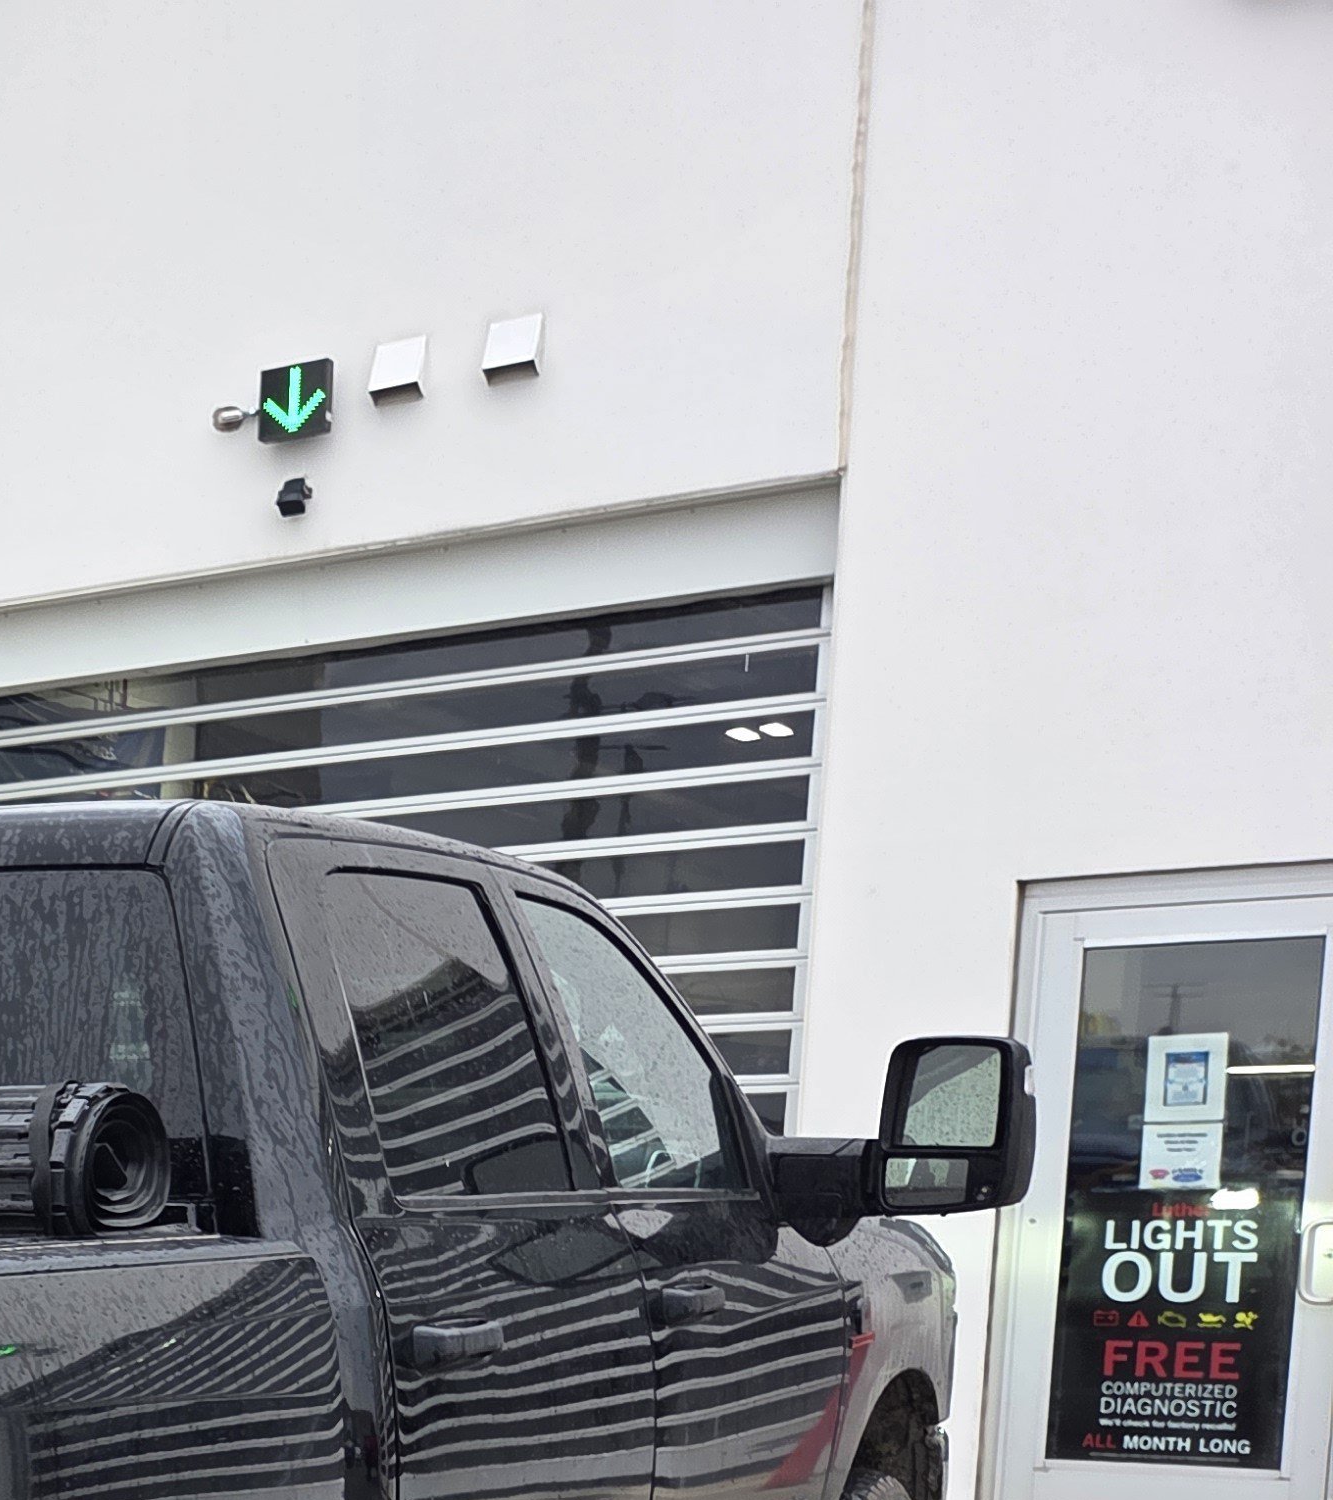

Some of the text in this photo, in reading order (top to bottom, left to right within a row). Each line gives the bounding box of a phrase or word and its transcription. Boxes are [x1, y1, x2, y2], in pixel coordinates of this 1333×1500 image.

[1104, 1219, 1259, 1250] LIGHTS
[1101, 1251, 1258, 1303] OUT
[1103, 1339, 1242, 1380] FREE
[1101, 1380, 1238, 1399] COMPUTERIZED
[1099, 1396, 1237, 1419] DIAGNOSTIC
[1082, 1432, 1251, 1455] ALL MONTH LONG
